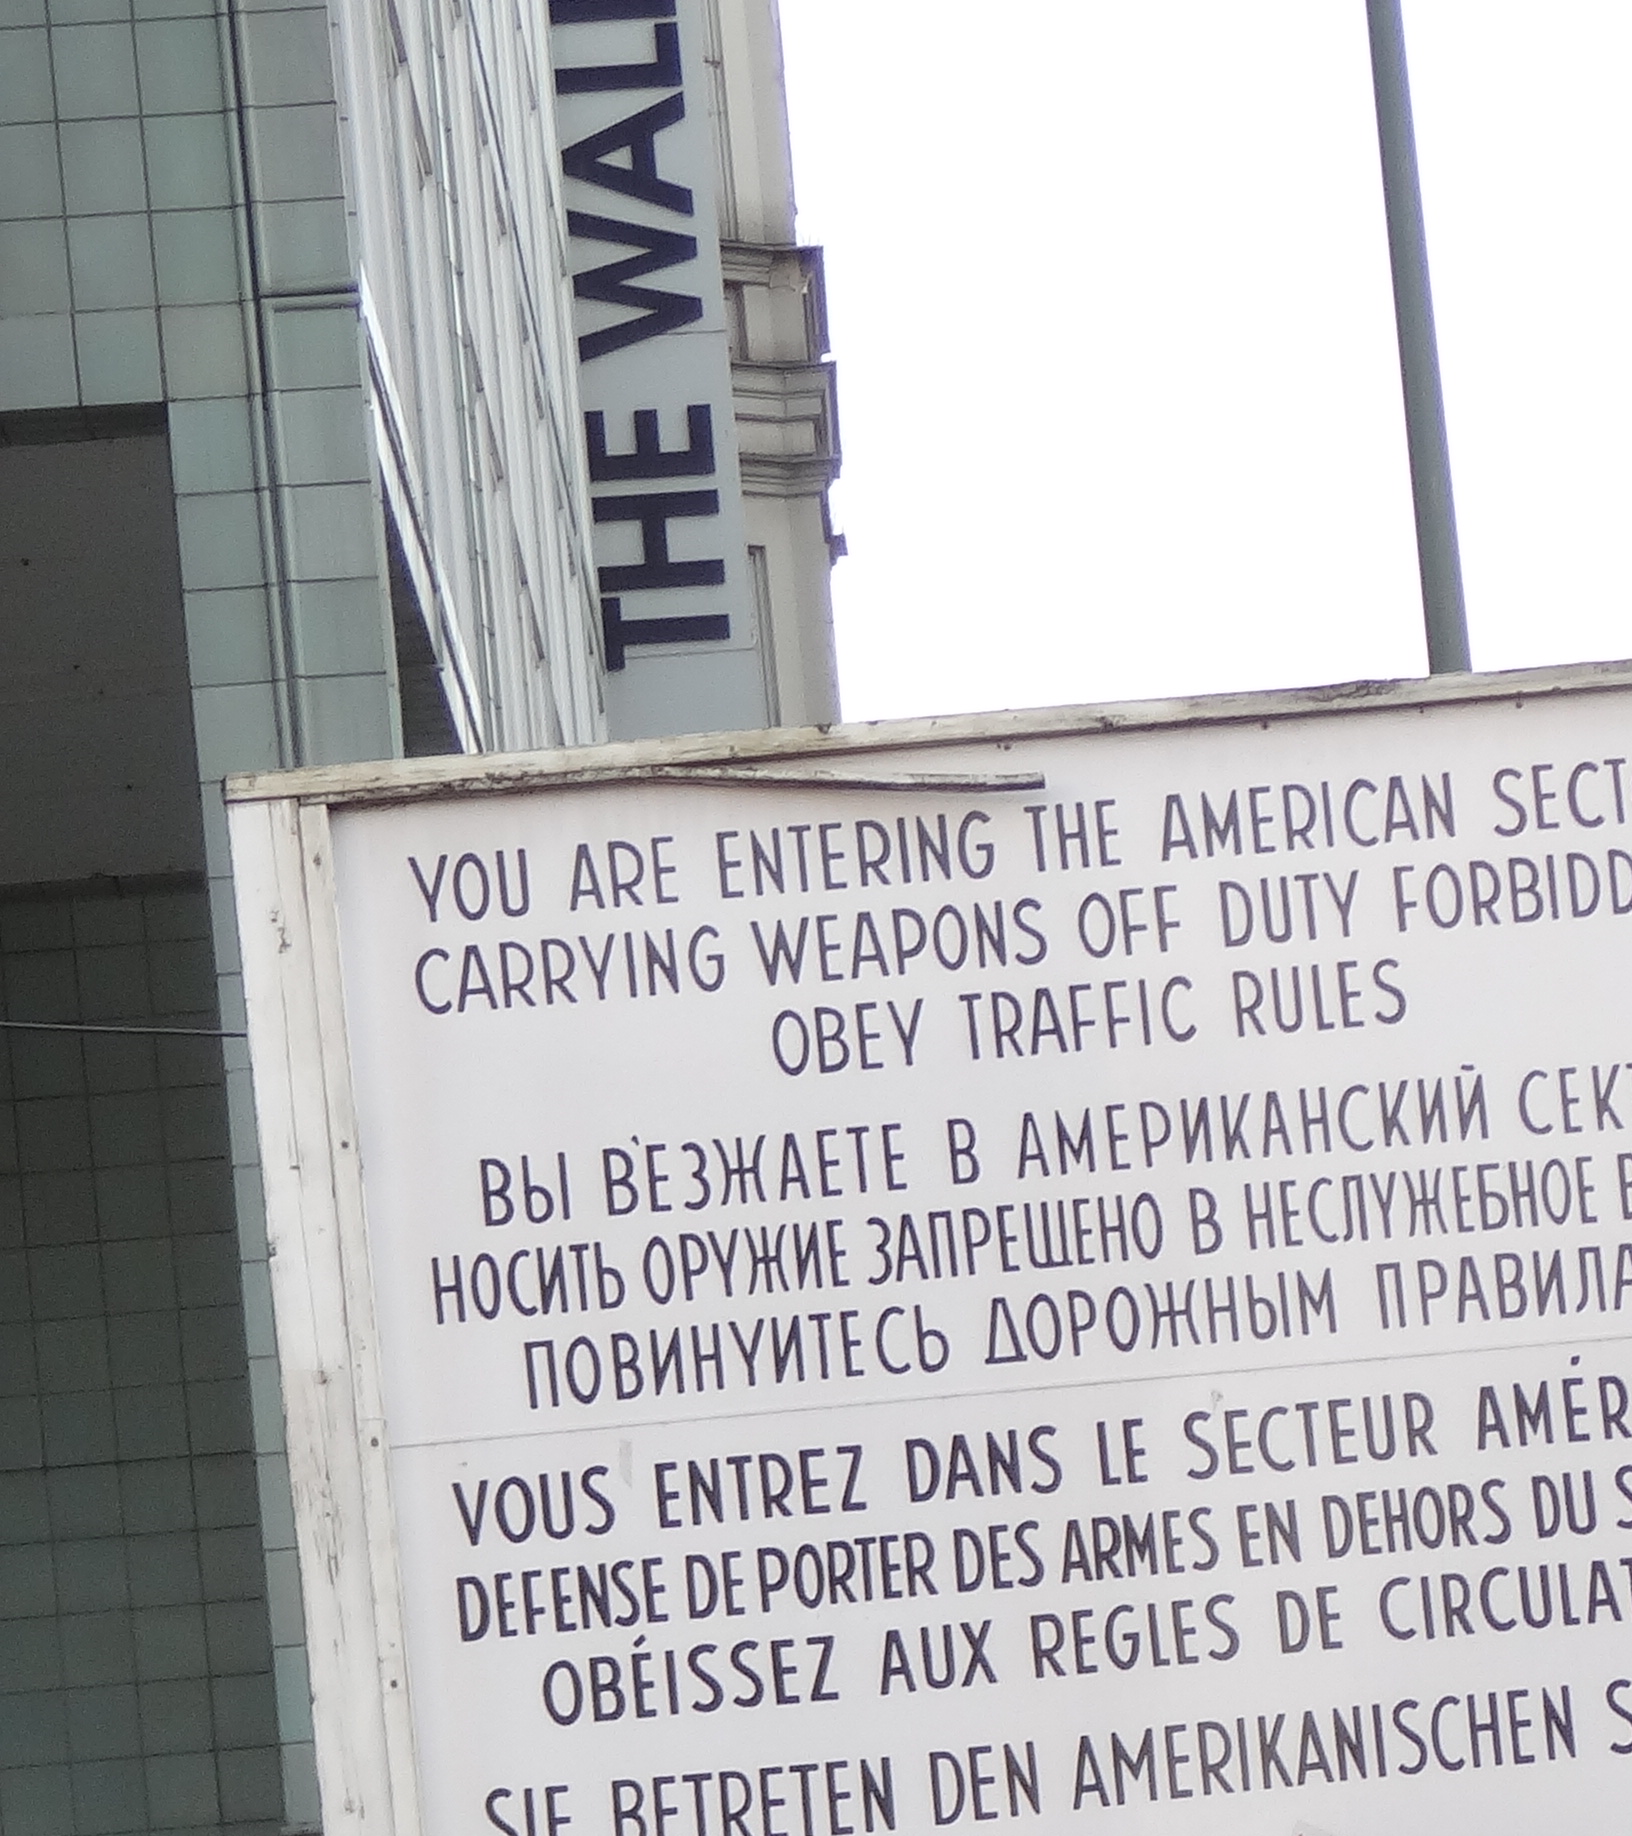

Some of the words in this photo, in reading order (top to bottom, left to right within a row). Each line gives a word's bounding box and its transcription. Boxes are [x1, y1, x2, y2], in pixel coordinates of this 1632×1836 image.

[583, 402, 731, 672] THE
[406, 847, 531, 922] YOU
[568, 835, 681, 913] ARE
[714, 808, 996, 900] ENTERING
[1018, 798, 1123, 874] THE
[1160, 770, 1457, 863] AMERICAN
[413, 923, 726, 1017] CARRYING
[748, 896, 1049, 988] WEAPONS
[1076, 883, 1182, 960] OFF
[1217, 868, 1360, 949] DUTY
[770, 996, 925, 1078] OBEY
[957, 974, 1198, 1062] TRAFFIC
[1230, 957, 1408, 1039] RULES
[478, 1150, 572, 1228] ВЫ
[945, 1116, 982, 1186] В
[1016, 1063, 1490, 1181] АМЕРИКАНСКИЙ
[429, 1240, 627, 1327] НОСИТЬ
[641, 1217, 852, 1307] ОРУЖИЕ
[1187, 1186, 1224, 1257] В
[1242, 1154, 1599, 1252] НЕСЛУЖЕБНОЕ
[983, 1266, 1338, 1367] ДОРОЖНЫМ
[450, 1464, 617, 1548] VOUS
[652, 1443, 869, 1530] ENTREZ
[903, 1423, 1064, 1505] DANS
[1095, 1416, 1150, 1488] LE
[1182, 1390, 1440, 1482] SECTEUR
[454, 1555, 670, 1644] DEFENSE
[683, 1549, 747, 1621] DE
[755, 1530, 940, 1615] PORTER
[951, 1518, 1046, 1595] DES
[1060, 1505, 1221, 1585] ARMES
[1234, 1497, 1303, 1569] EN
[1320, 1477, 1513, 1560] DEHORS
[1529, 1468, 1598, 1540] DU
[541, 1633, 841, 1728] OBÉISSEZ
[878, 1618, 1000, 1697] AUX
[1028, 1592, 1241, 1680] REGLES
[1274, 1584, 1345, 1656] DE
[927, 1739, 1042, 1827] DEN
[1071, 1683, 1578, 1812] AMERIKANISCHEN
